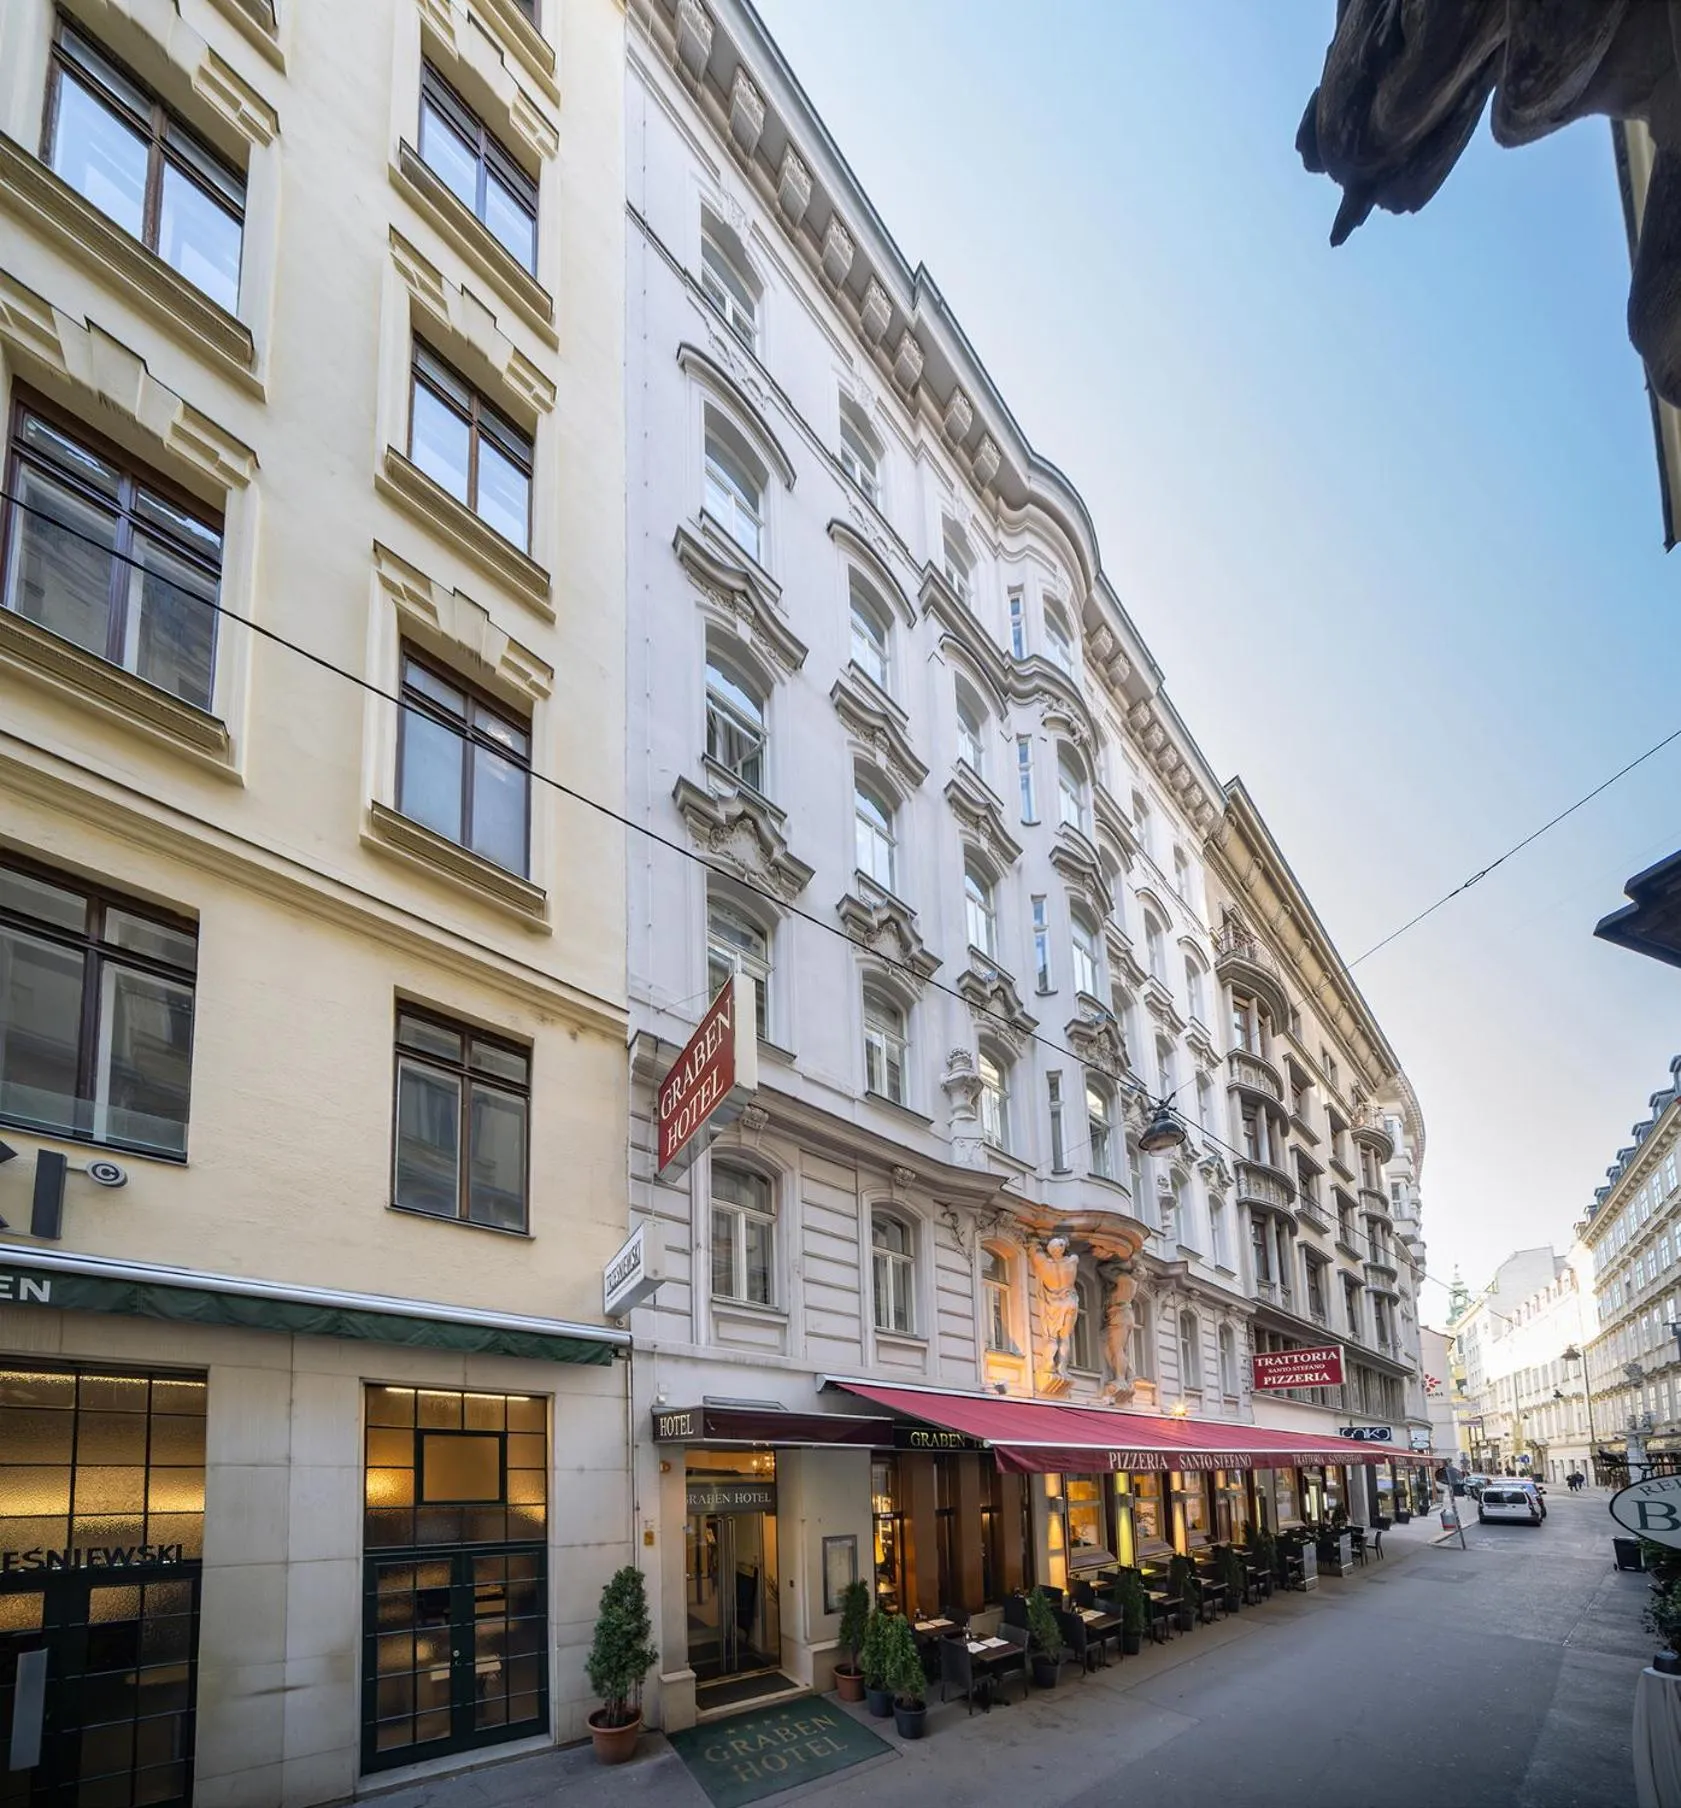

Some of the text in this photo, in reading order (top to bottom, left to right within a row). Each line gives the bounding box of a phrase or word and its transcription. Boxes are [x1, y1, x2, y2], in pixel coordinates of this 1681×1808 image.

[661, 999, 732, 1120] GRABEN
[666, 1065, 724, 1156] HOTEL
[1255, 1351, 1338, 1367] TRATTORIA
[1292, 1363, 1325, 1371] STEFANO
[1264, 1372, 1331, 1386] PIZZERIA
[660, 1414, 694, 1436] HOTEL
[910, 1431, 965, 1448] GRABEN
[1109, 1452, 1252, 1470] PIZZERIA SANTO STEFANO
[686, 1492, 771, 1505] RABEN HOTEL
[704, 1714, 838, 1763] GRABEN
[732, 1736, 848, 1782] HOTEL
